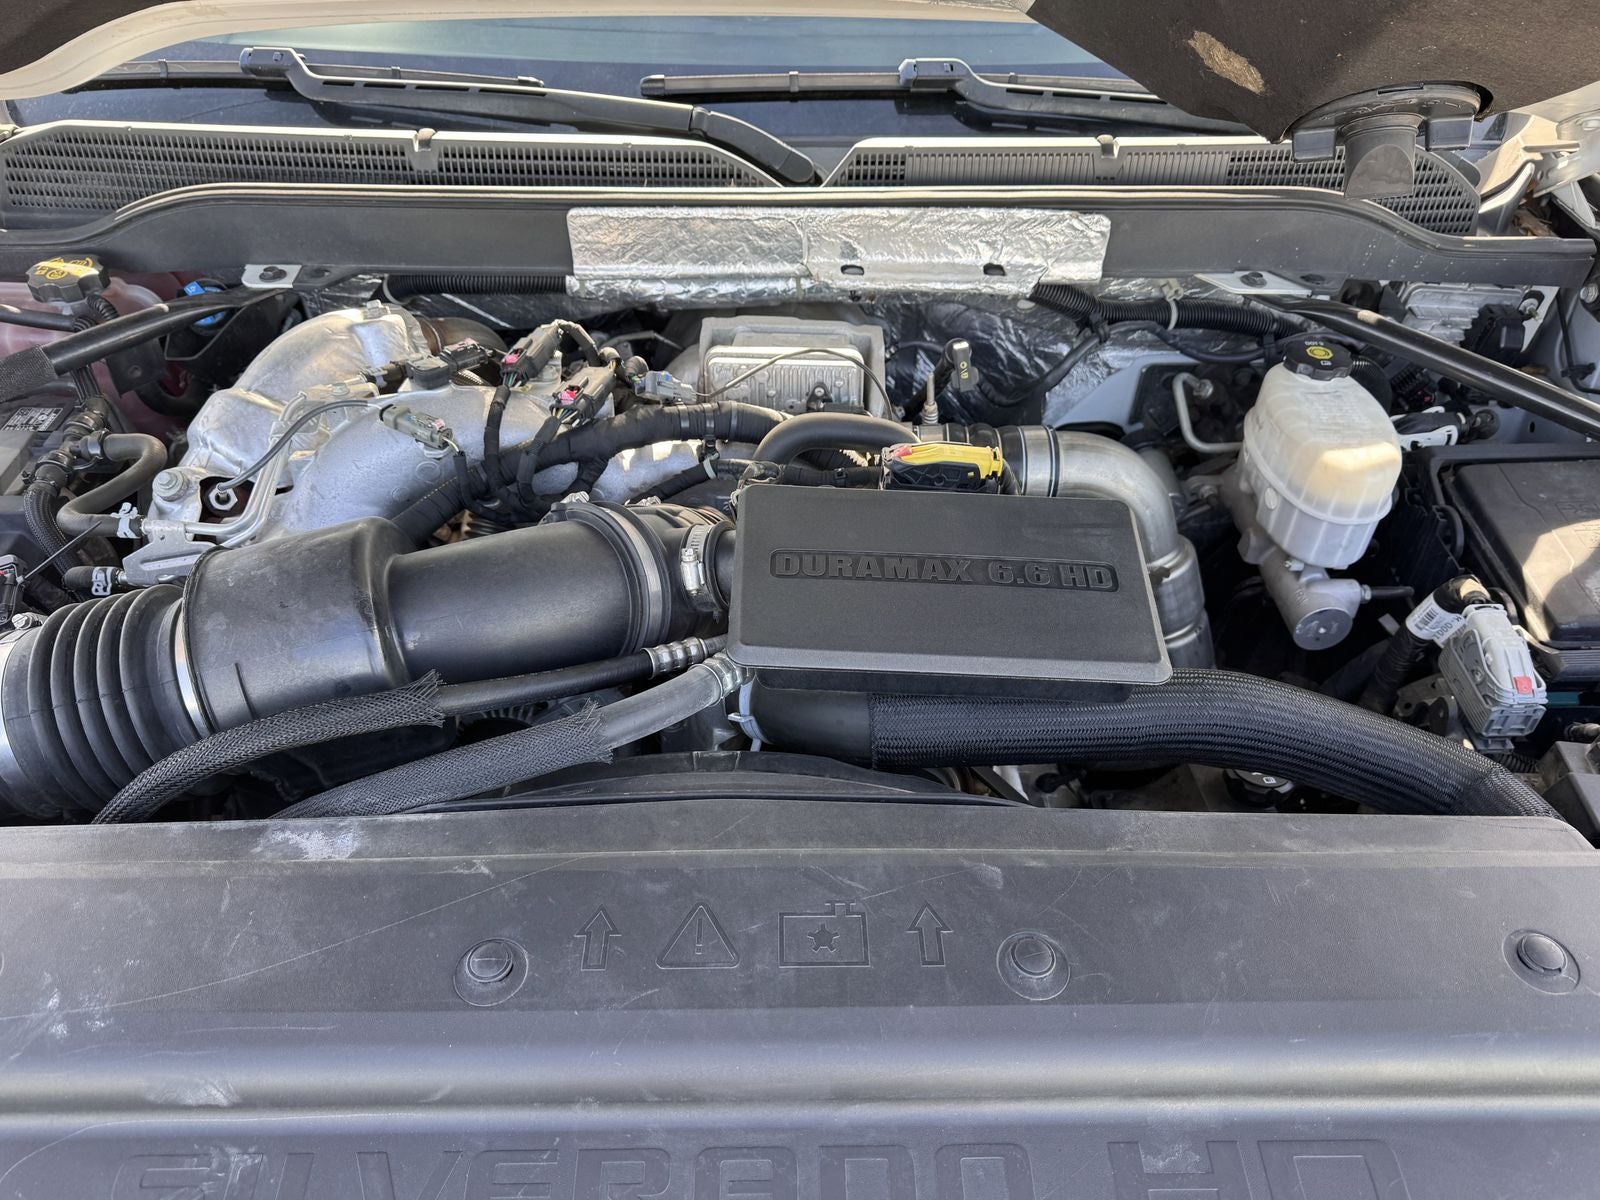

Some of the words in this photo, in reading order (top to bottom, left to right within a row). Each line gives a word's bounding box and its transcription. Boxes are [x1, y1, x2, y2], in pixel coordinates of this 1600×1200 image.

[775, 552, 973, 583] DURAMAX
[987, 560, 1051, 586] 6.6
[1058, 563, 1114, 590] HD
